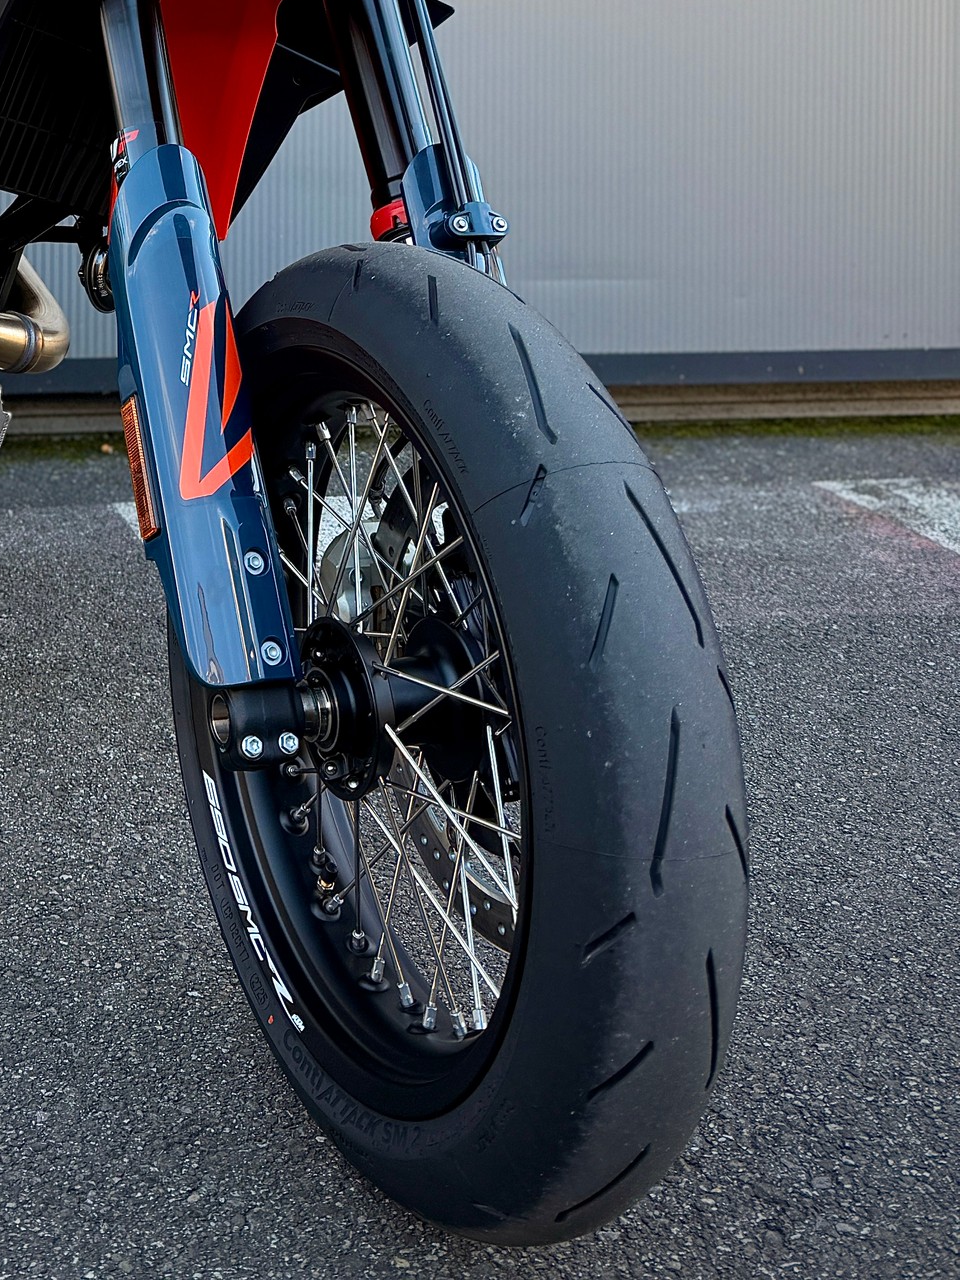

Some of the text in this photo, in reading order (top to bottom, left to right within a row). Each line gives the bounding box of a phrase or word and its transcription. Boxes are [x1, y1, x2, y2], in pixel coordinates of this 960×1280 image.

[211, 863, 226, 891] DOT
[282, 1028, 326, 1094] Conti
[315, 1083, 384, 1137] ATTACK
